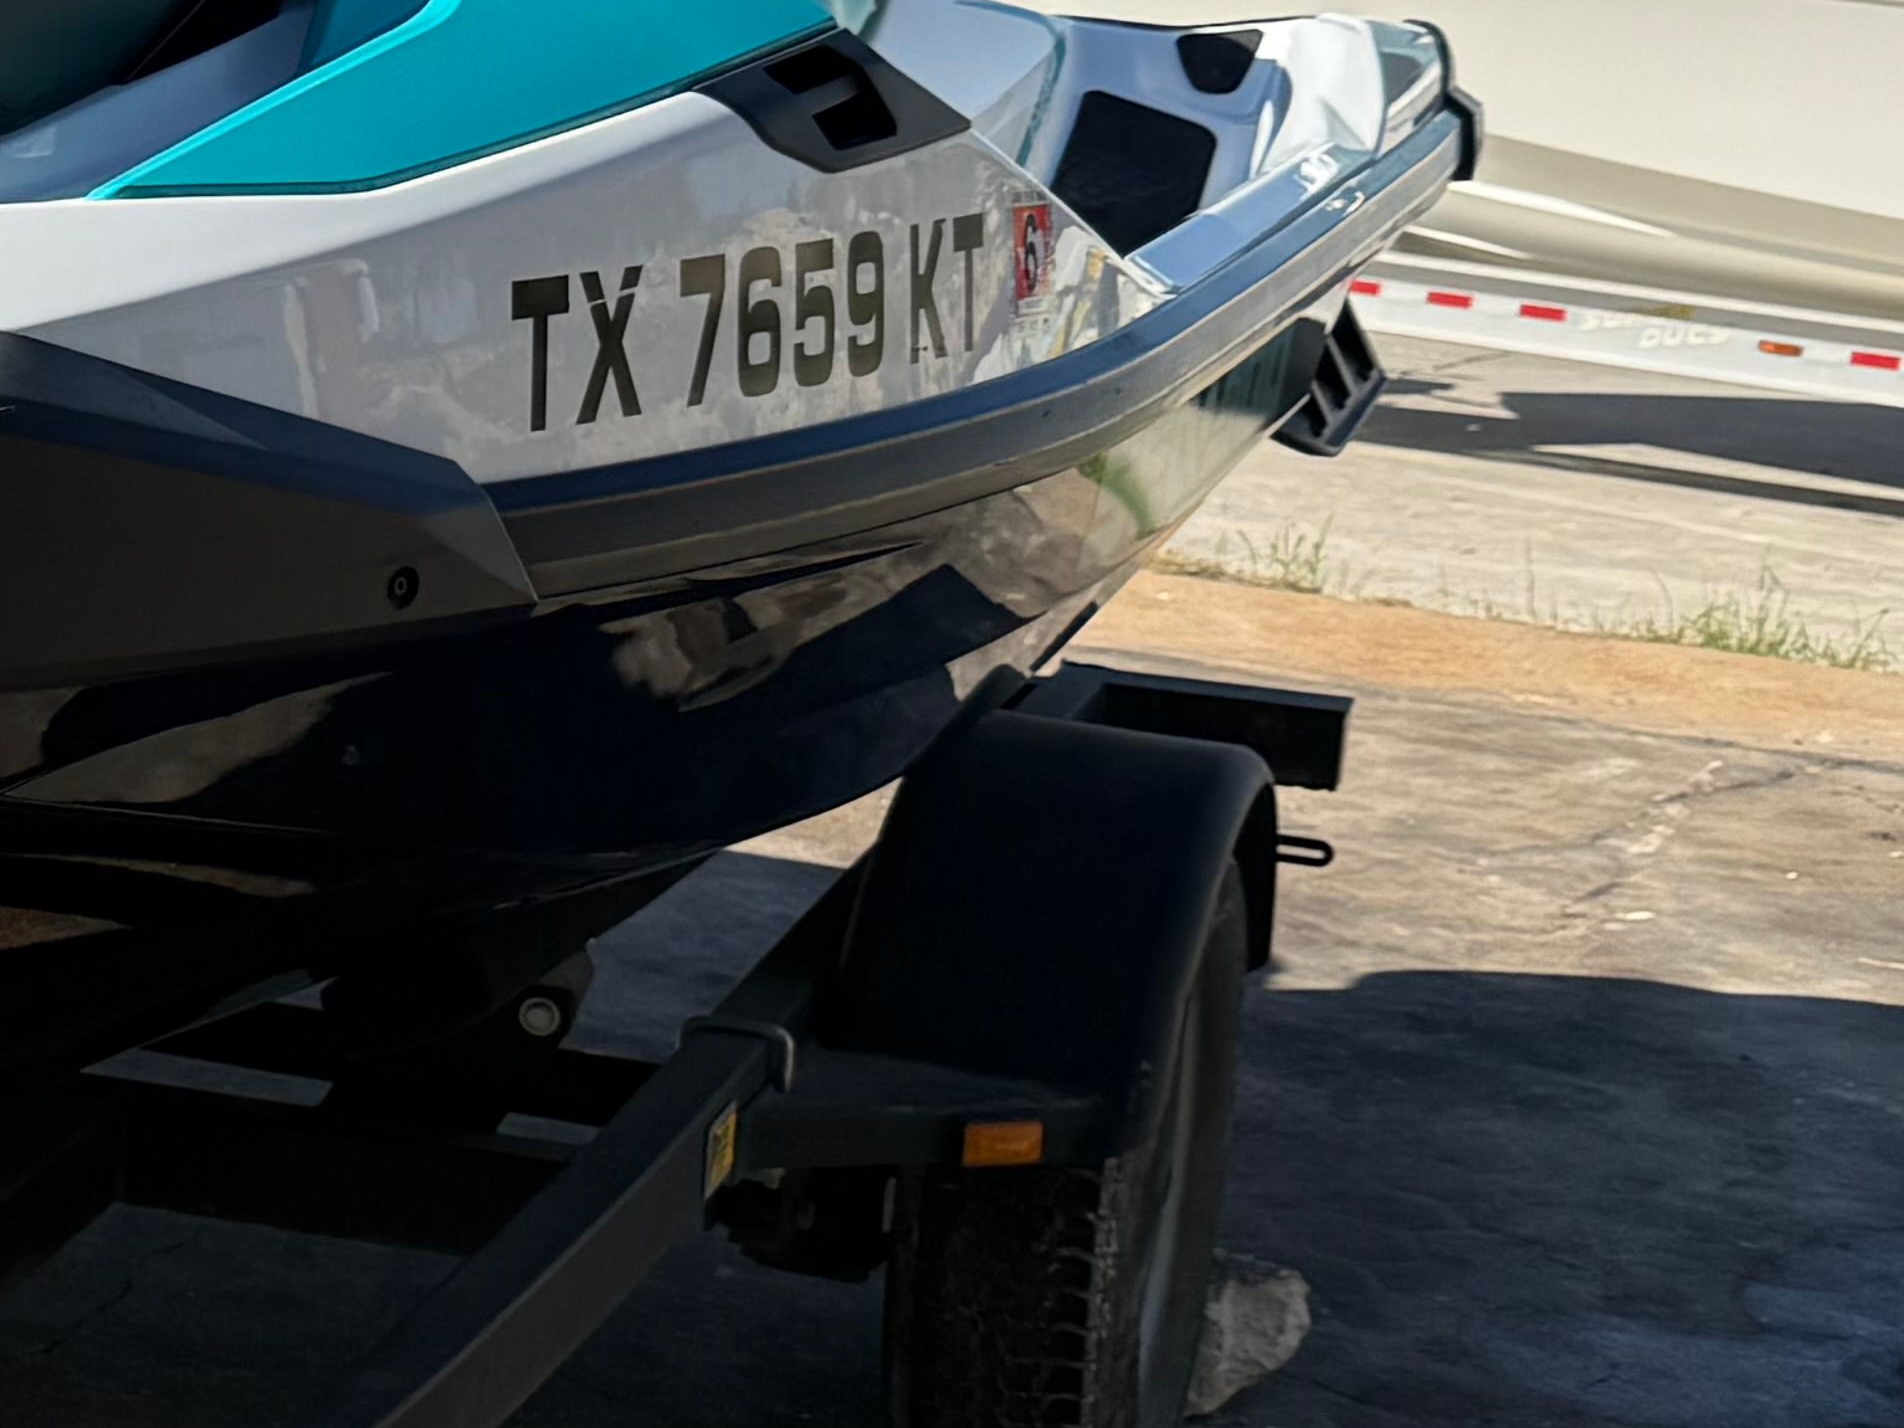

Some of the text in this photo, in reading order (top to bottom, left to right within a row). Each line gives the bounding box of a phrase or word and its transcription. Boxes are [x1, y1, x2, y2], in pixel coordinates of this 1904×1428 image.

[510, 213, 984, 432] TX 7659 KT
[1024, 213, 1038, 293] 6
